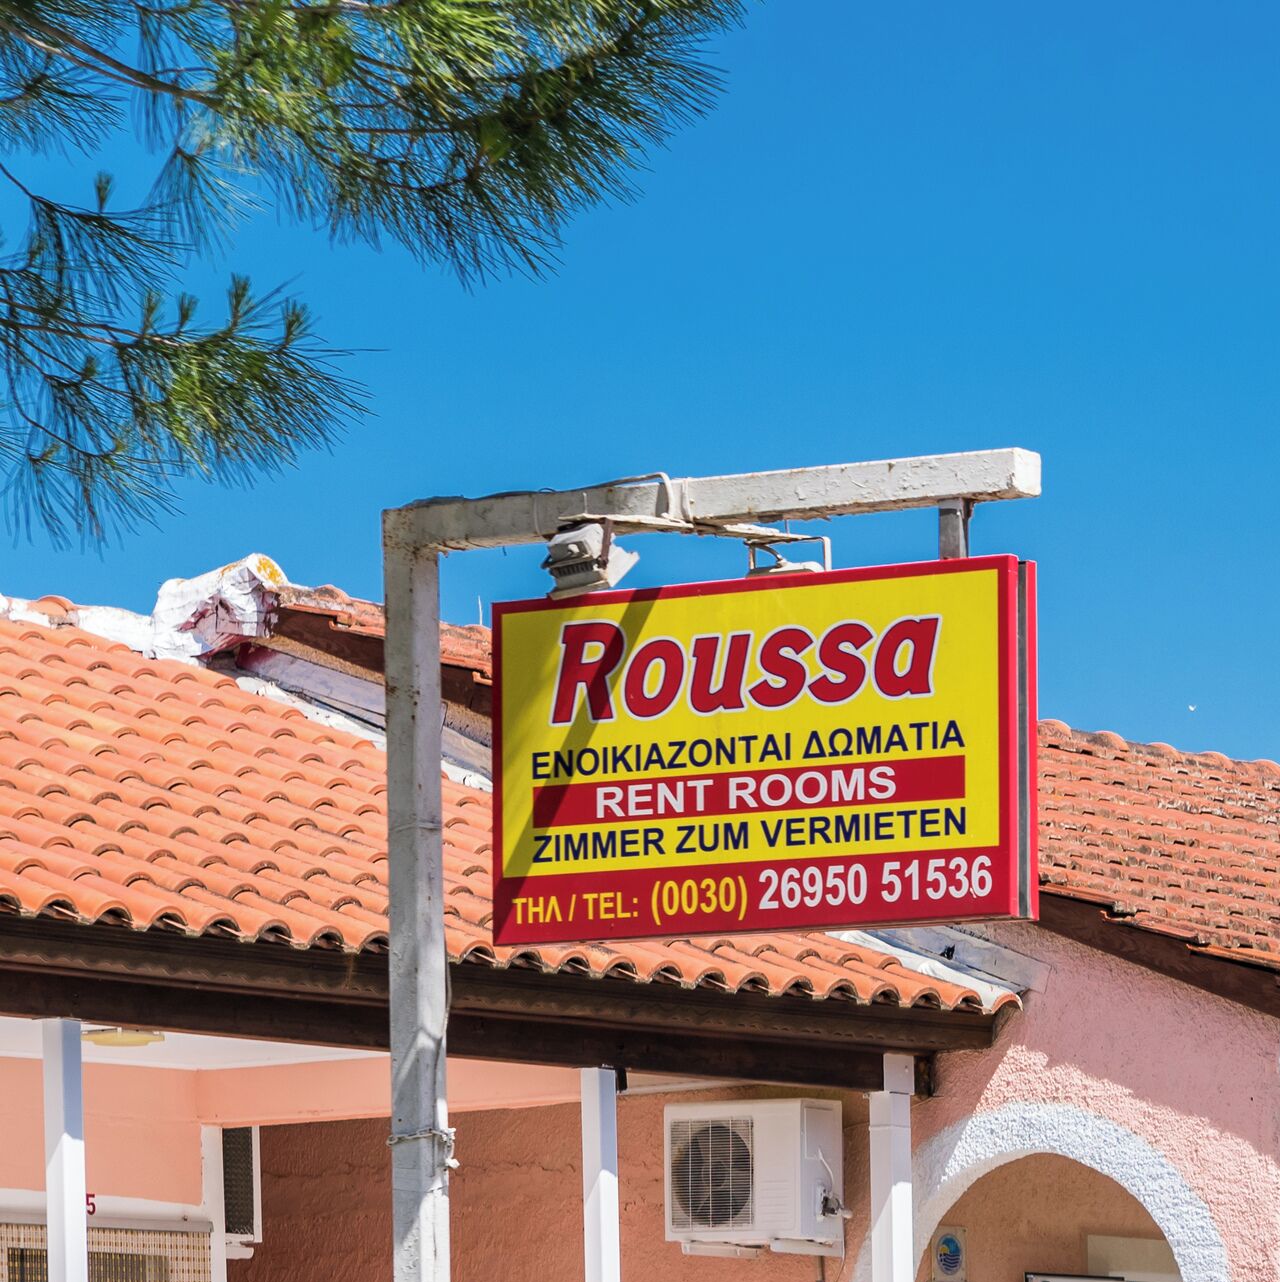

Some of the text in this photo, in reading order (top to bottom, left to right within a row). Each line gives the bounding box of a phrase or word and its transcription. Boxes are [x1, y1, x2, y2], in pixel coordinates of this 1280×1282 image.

[550, 614, 942, 727] Roussa
[531, 719, 966, 780] ΕΝΟΙΚΙΑΖΟΝΤΑΙ ΔΩΜΑΤΙΑ
[596, 766, 897, 819] RENT ROOMS
[532, 806, 966, 863] ZIMMER ZUM VERMIETEN
[582, 891, 639, 920] TEL:
[651, 875, 748, 926] (0030)
[758, 863, 867, 910] 26950
[881, 855, 993, 902] 51536
